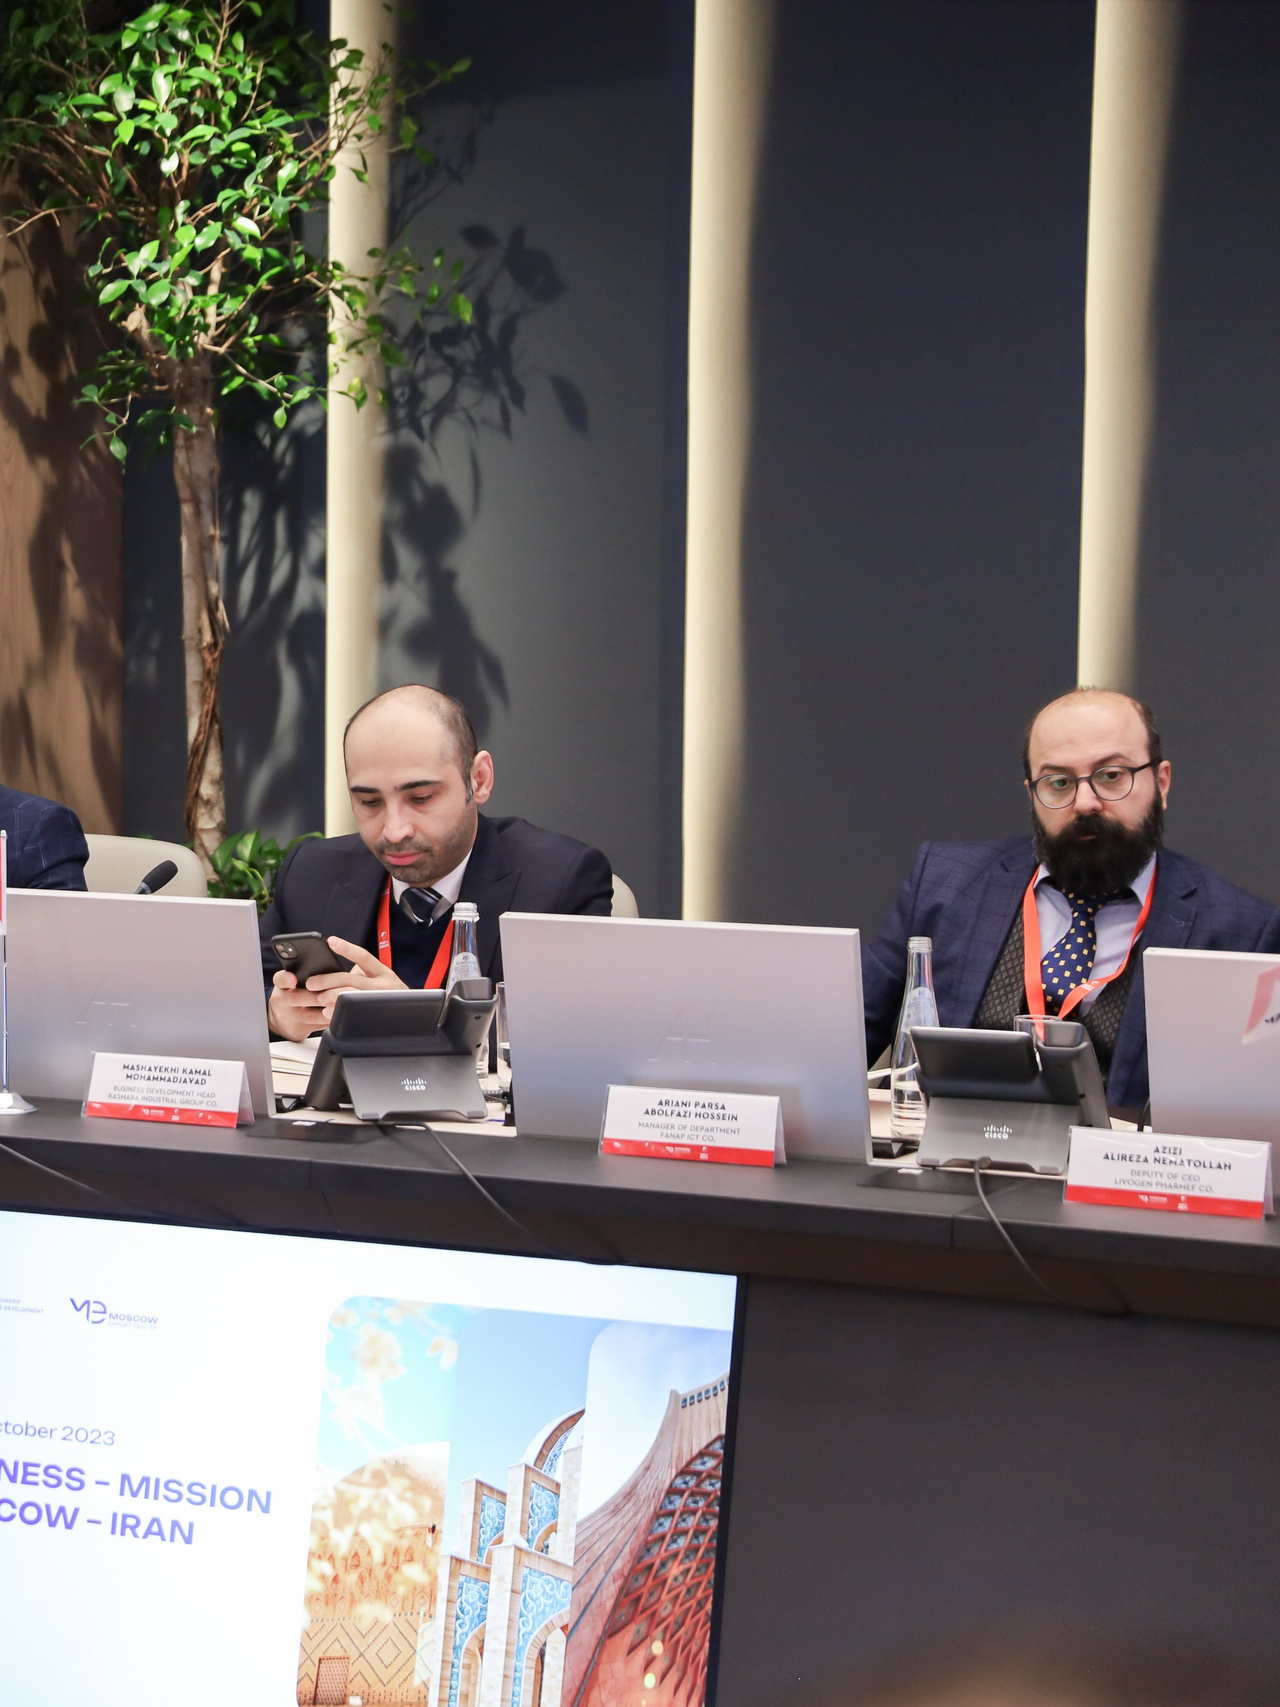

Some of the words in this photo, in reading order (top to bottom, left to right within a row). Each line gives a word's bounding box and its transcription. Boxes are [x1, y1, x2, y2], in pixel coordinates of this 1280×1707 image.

[122, 1063, 180, 1074] MASHAYEKHI
[182, 1067, 212, 1076] KAMAL
[126, 1073, 207, 1086] MOHAMMADJAVAD
[113, 1084, 145, 1094] BUSINESS
[146, 1087, 196, 1098] DEVELOPMENT
[108, 1092, 140, 1101] RASMARA
[140, 1095, 178, 1104] INDUSTRAL
[180, 1098, 204, 1106] GROUP
[206, 1100, 219, 1108] CO.
[657, 1099, 691, 1108] ARIANI
[694, 1101, 726, 1111] PARSA
[644, 1108, 692, 1118] ABOLFAZI
[694, 1111, 738, 1122] HOSSEIN
[638, 1121, 676, 1130] MANAGER
[690, 1124, 741, 1136] DEPARTMENT
[660, 1132, 686, 1140] FANAP
[702, 1134, 716, 1142] CO.
[1153, 1146, 1182, 1154] AZIZI
[1102, 1152, 1149, 1164] ALIREZA
[1153, 1156, 1232, 1171] NEMATOLLAH
[1130, 1169, 1164, 1179] DEPUTY
[1166, 1172, 1180, 1180] OF
[1181, 1174, 1200, 1182] CEO
[1114, 1178, 1153, 1188] LIVOGEN
[1198, 1184, 1215, 1193] CO.
[4, 1306, 44, 1314] DEVELOPMENT
[108, 1312, 158, 1324] MOSCOW
[61, 1426, 116, 1447] 2023
[119, 1473, 272, 1514] MISSION
[110, 1512, 194, 1545] IRAN
